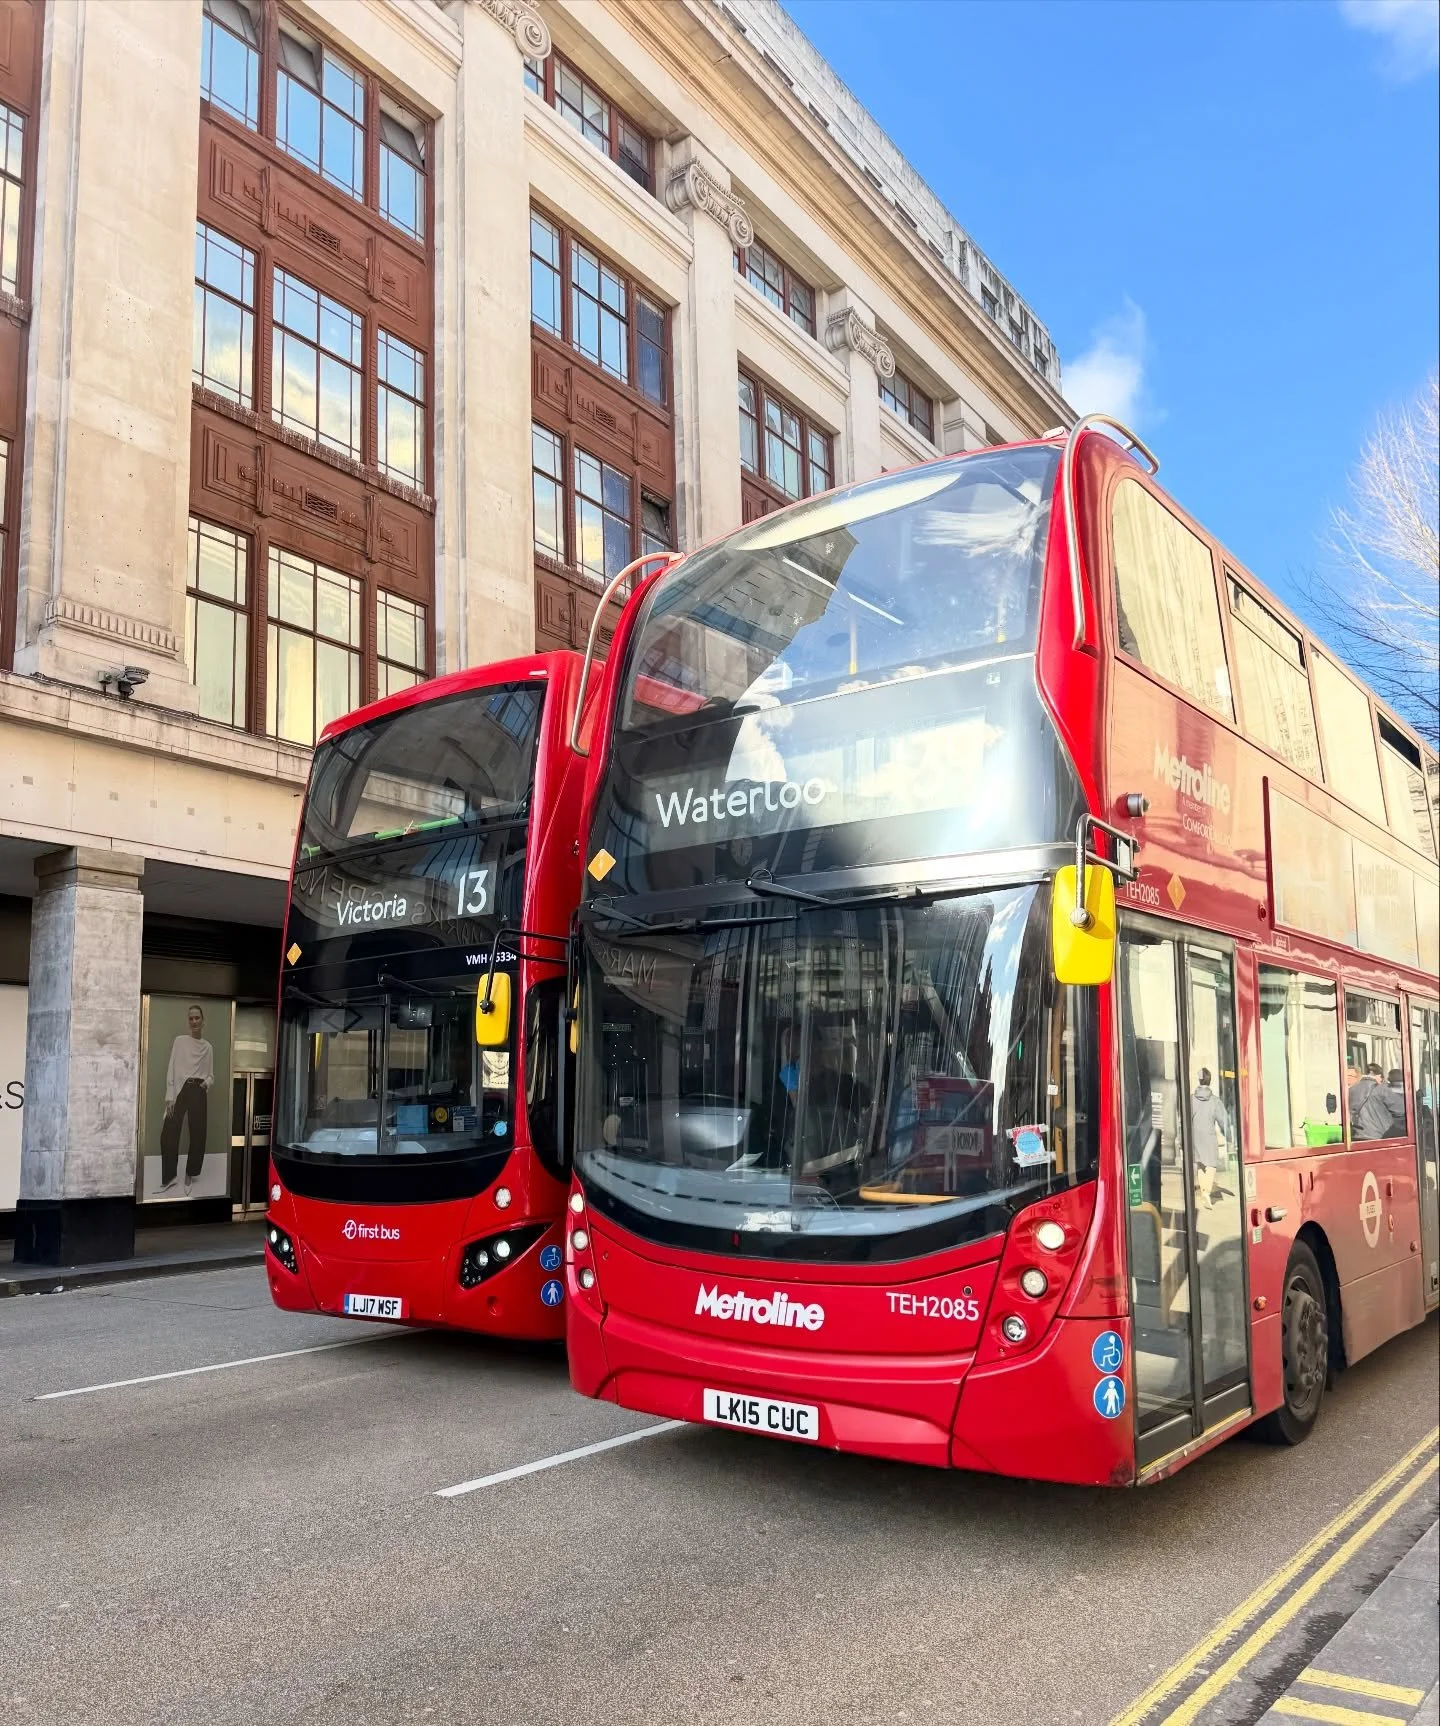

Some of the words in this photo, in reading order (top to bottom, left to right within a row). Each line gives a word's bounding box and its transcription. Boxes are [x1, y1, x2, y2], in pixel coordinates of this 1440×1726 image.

[1153, 743, 1231, 815] Metroline
[656, 776, 826, 828] Waterloo
[457, 869, 489, 915] 13
[1125, 880, 1160, 906] TEH2085
[336, 894, 407, 925] Victoria
[465, 953, 488, 966] VMH
[0, 1081, 25, 1110] S
[358, 1223, 379, 1239] first
[381, 1223, 400, 1240] bus
[352, 1297, 376, 1314] LJ17
[378, 1299, 399, 1316] WSF
[694, 1283, 825, 1331] Metroline
[886, 1292, 980, 1322] TEH2085
[716, 1395, 760, 1426] LK15
[767, 1404, 810, 1436] CUC
